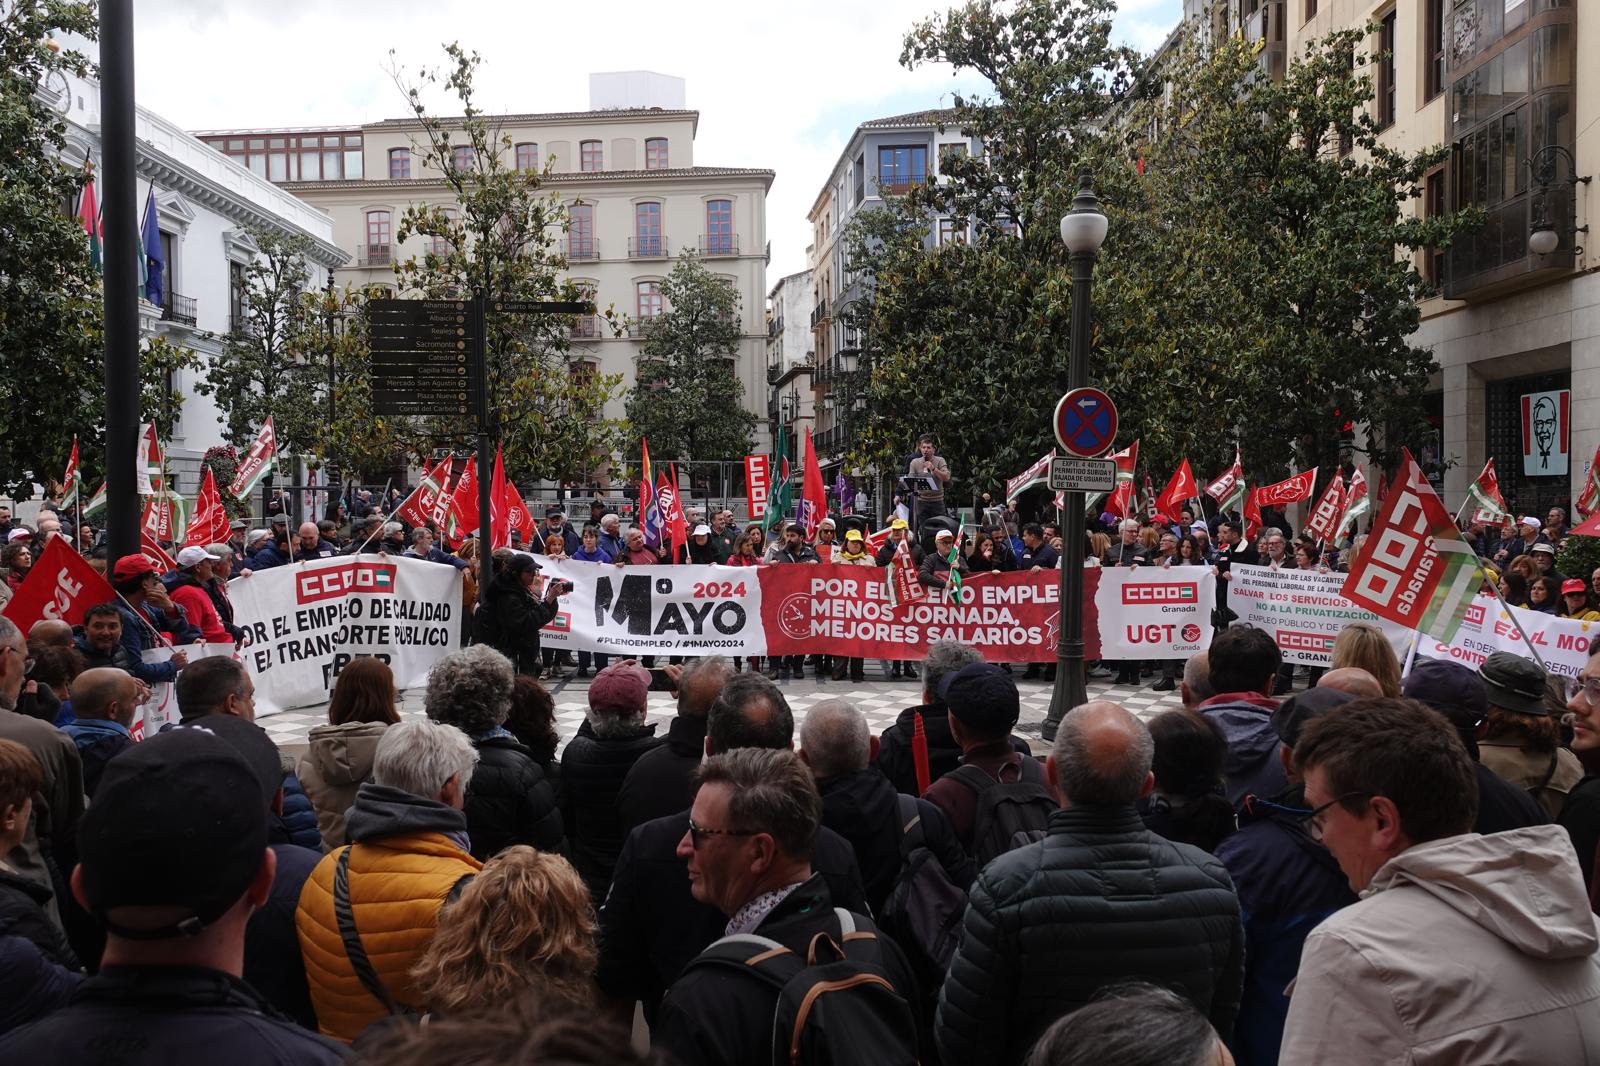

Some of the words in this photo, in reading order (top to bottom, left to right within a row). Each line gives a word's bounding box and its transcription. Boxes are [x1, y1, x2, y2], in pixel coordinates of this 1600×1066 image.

[1054, 467, 1086, 475] PERMITIDO
[1086, 468, 1108, 476] SUBIDA
[748, 456, 767, 518] CCOO
[899, 567, 910, 601] Granada
[1240, 568, 1250, 576] POR
[1257, 570, 1289, 580] COBERTURA
[1290, 573, 1299, 581] DE
[1300, 574, 1312, 582] LAS
[1314, 576, 1344, 585] VACANTES
[1242, 578, 1251, 586] DEL
[1252, 579, 1278, 589] PERSONAL
[1280, 582, 1306, 591] LABORAL
[1307, 584, 1316, 592] DE
[1317, 585, 1325, 593] LA
[41, 566, 84, 620] SOE
[693, 581, 746, 598] 2024
[811, 578, 858, 597] POR
[865, 581, 888, 600] EL
[981, 585, 1063, 605] EMPLE
[1126, 586, 1180, 600] CCOO
[1233, 587, 1264, 599] SALVAR
[1270, 592, 1289, 601] LOS
[1291, 593, 1348, 608] SERVICIOS
[810, 599, 894, 622] MENOS
[900, 605, 1020, 627] JORNADA,
[1162, 605, 1196, 613] Granada
[1256, 602, 1267, 611] NO
[1270, 604, 1276, 612] A
[1280, 605, 1292, 614] LA
[1296, 606, 1380, 622] PRIVATIZACIÓN
[243, 621, 269, 648] OR
[272, 615, 291, 639] EL
[370, 598, 392, 619] DE
[393, 599, 451, 622] CALIDAD
[810, 619, 920, 643] MEJORES
[926, 626, 1042, 646] SALARIOS
[1248, 613, 1277, 625] EMPLEO
[1279, 617, 1316, 630] PÚBLICO
[1318, 622, 1325, 630] Y
[1327, 624, 1338, 632] DE
[1494, 620, 1522, 641] ES
[596, 636, 673, 648] #PLENOEMPLEO
[682, 640, 744, 648] #1MAYO2024
[1127, 624, 1177, 644] UGT
[1279, 634, 1324, 649] CCOO
[1463, 638, 1474, 648] EN
[254, 648, 272, 674] EL
[277, 625, 390, 665] TRANSORTE
[394, 622, 448, 647] PÚBLICO
